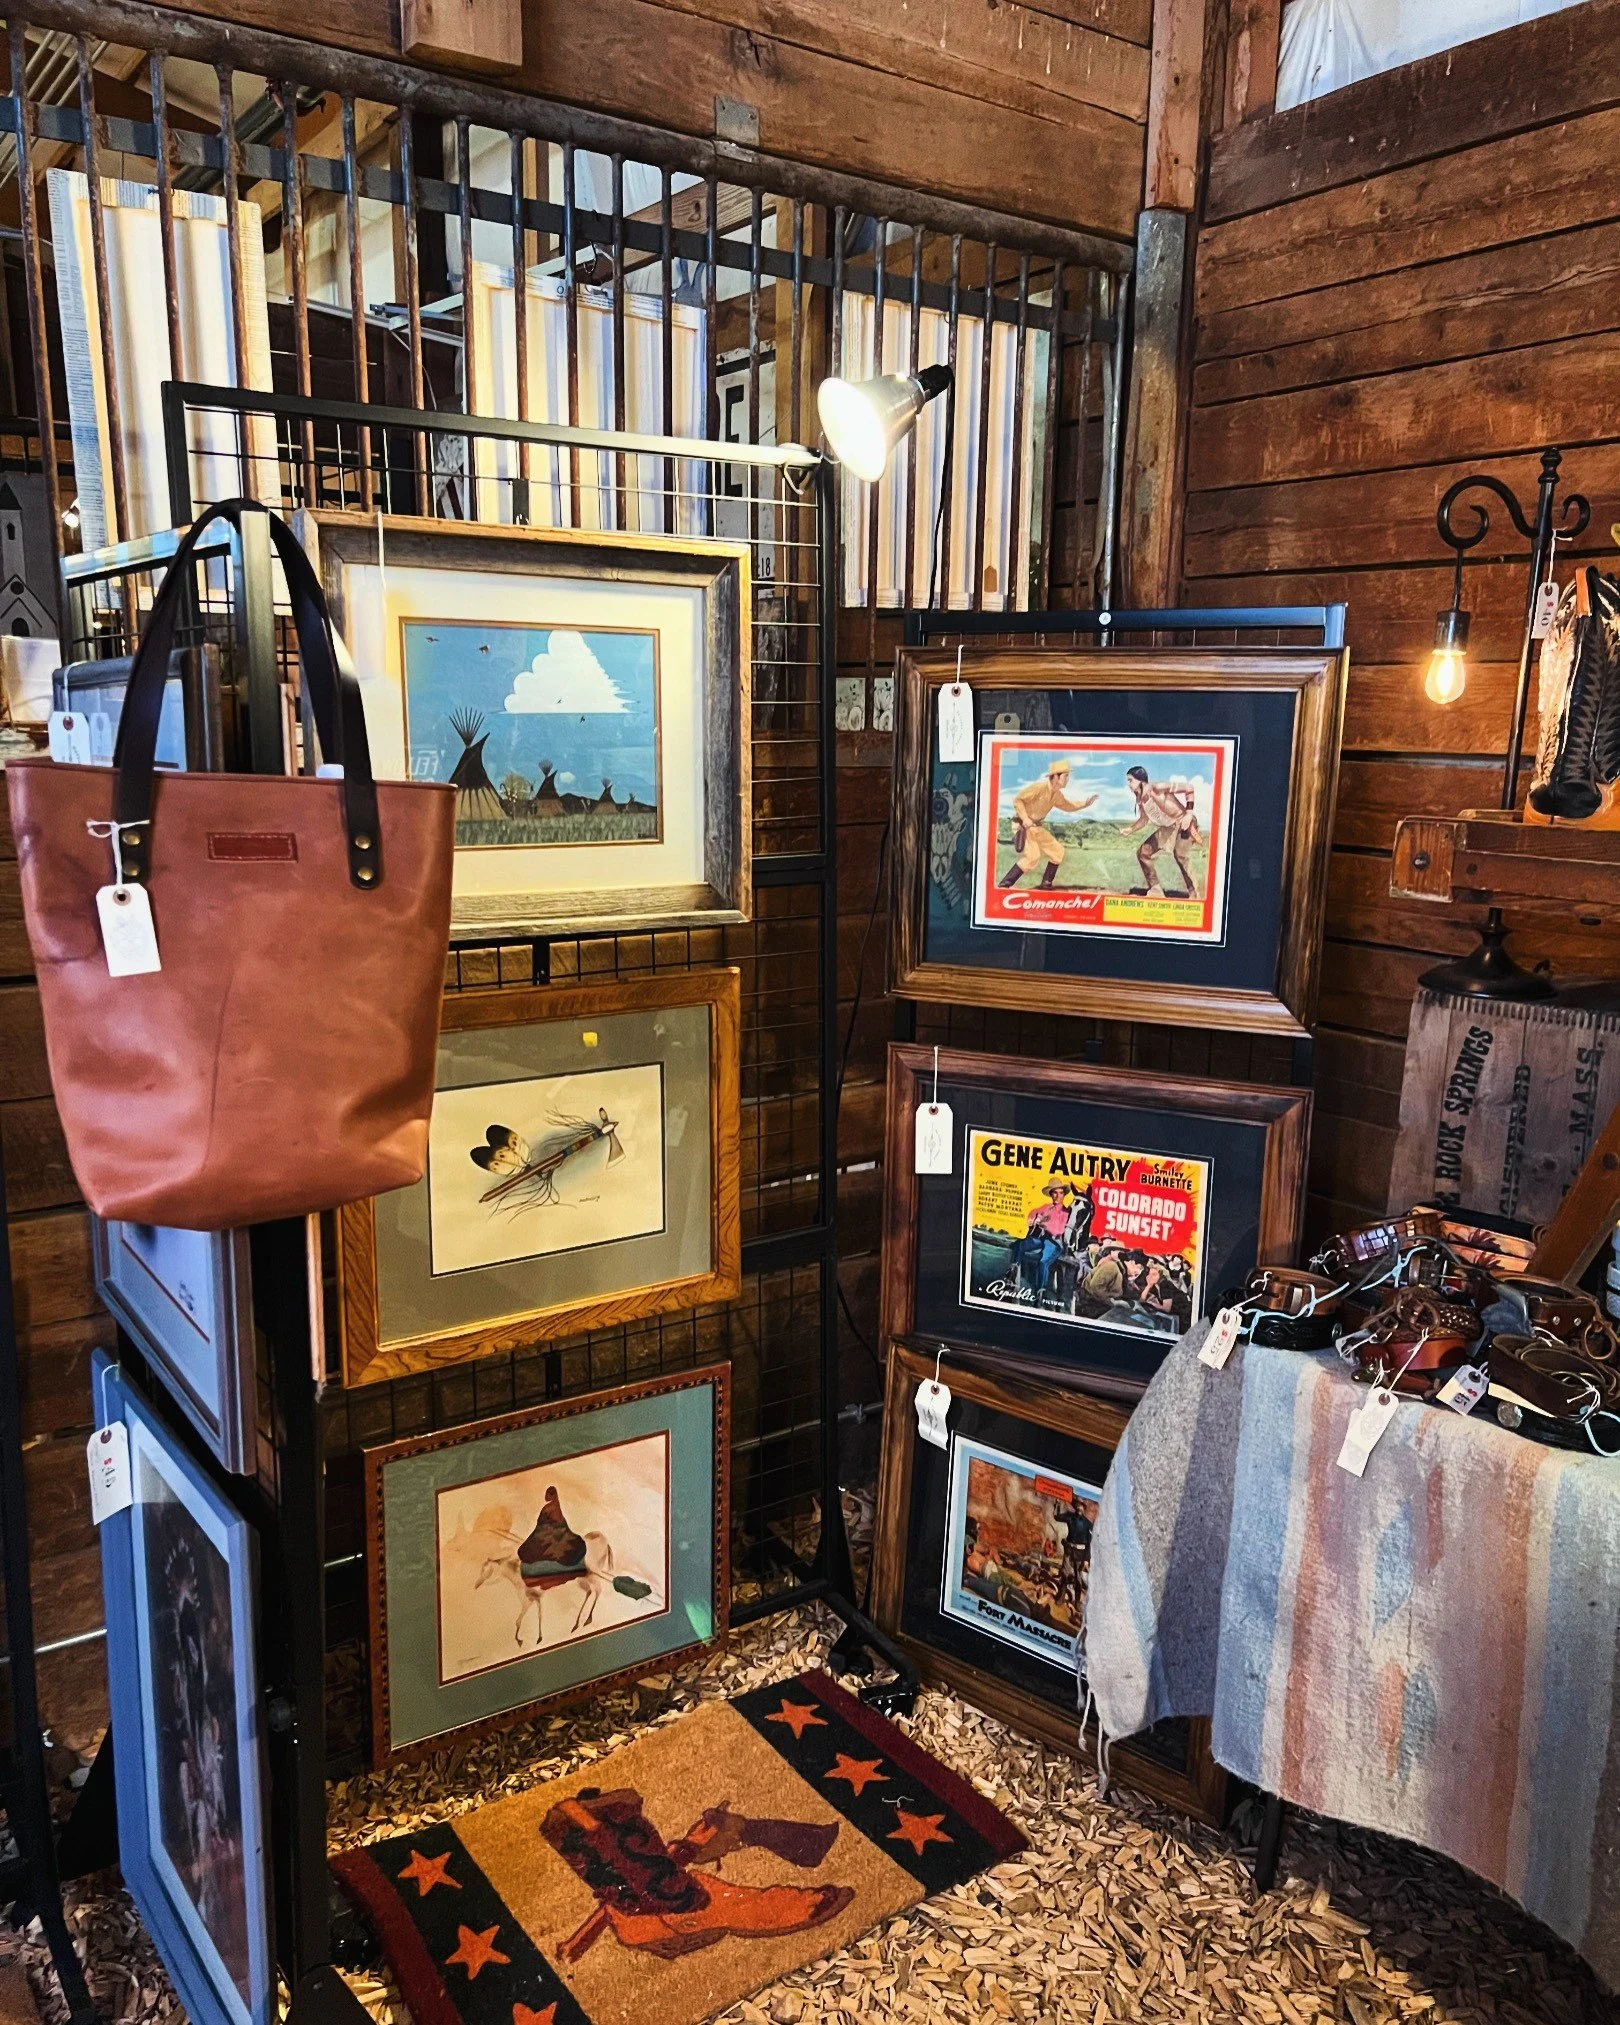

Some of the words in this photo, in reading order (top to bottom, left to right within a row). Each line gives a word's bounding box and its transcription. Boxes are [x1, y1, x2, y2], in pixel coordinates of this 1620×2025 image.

[1002, 892, 1102, 910] Comanche!
[1444, 1025, 1494, 1116] SPRINGS
[981, 1139, 1043, 1170] GENE
[1049, 1147, 1131, 1182] AUTRY
[1435, 1121, 1467, 1182] ROCK
[1141, 1174, 1192, 1190] BURNETTE
[1153, 1163, 1184, 1179] Smiley
[1098, 1187, 1187, 1222] COLORADO
[1105, 1210, 1172, 1241] SUNSET
[985, 1280, 1037, 1301] Republic
[977, 1599, 1007, 1621] FORT
[1007, 1613, 1073, 1651] MASSACRE
